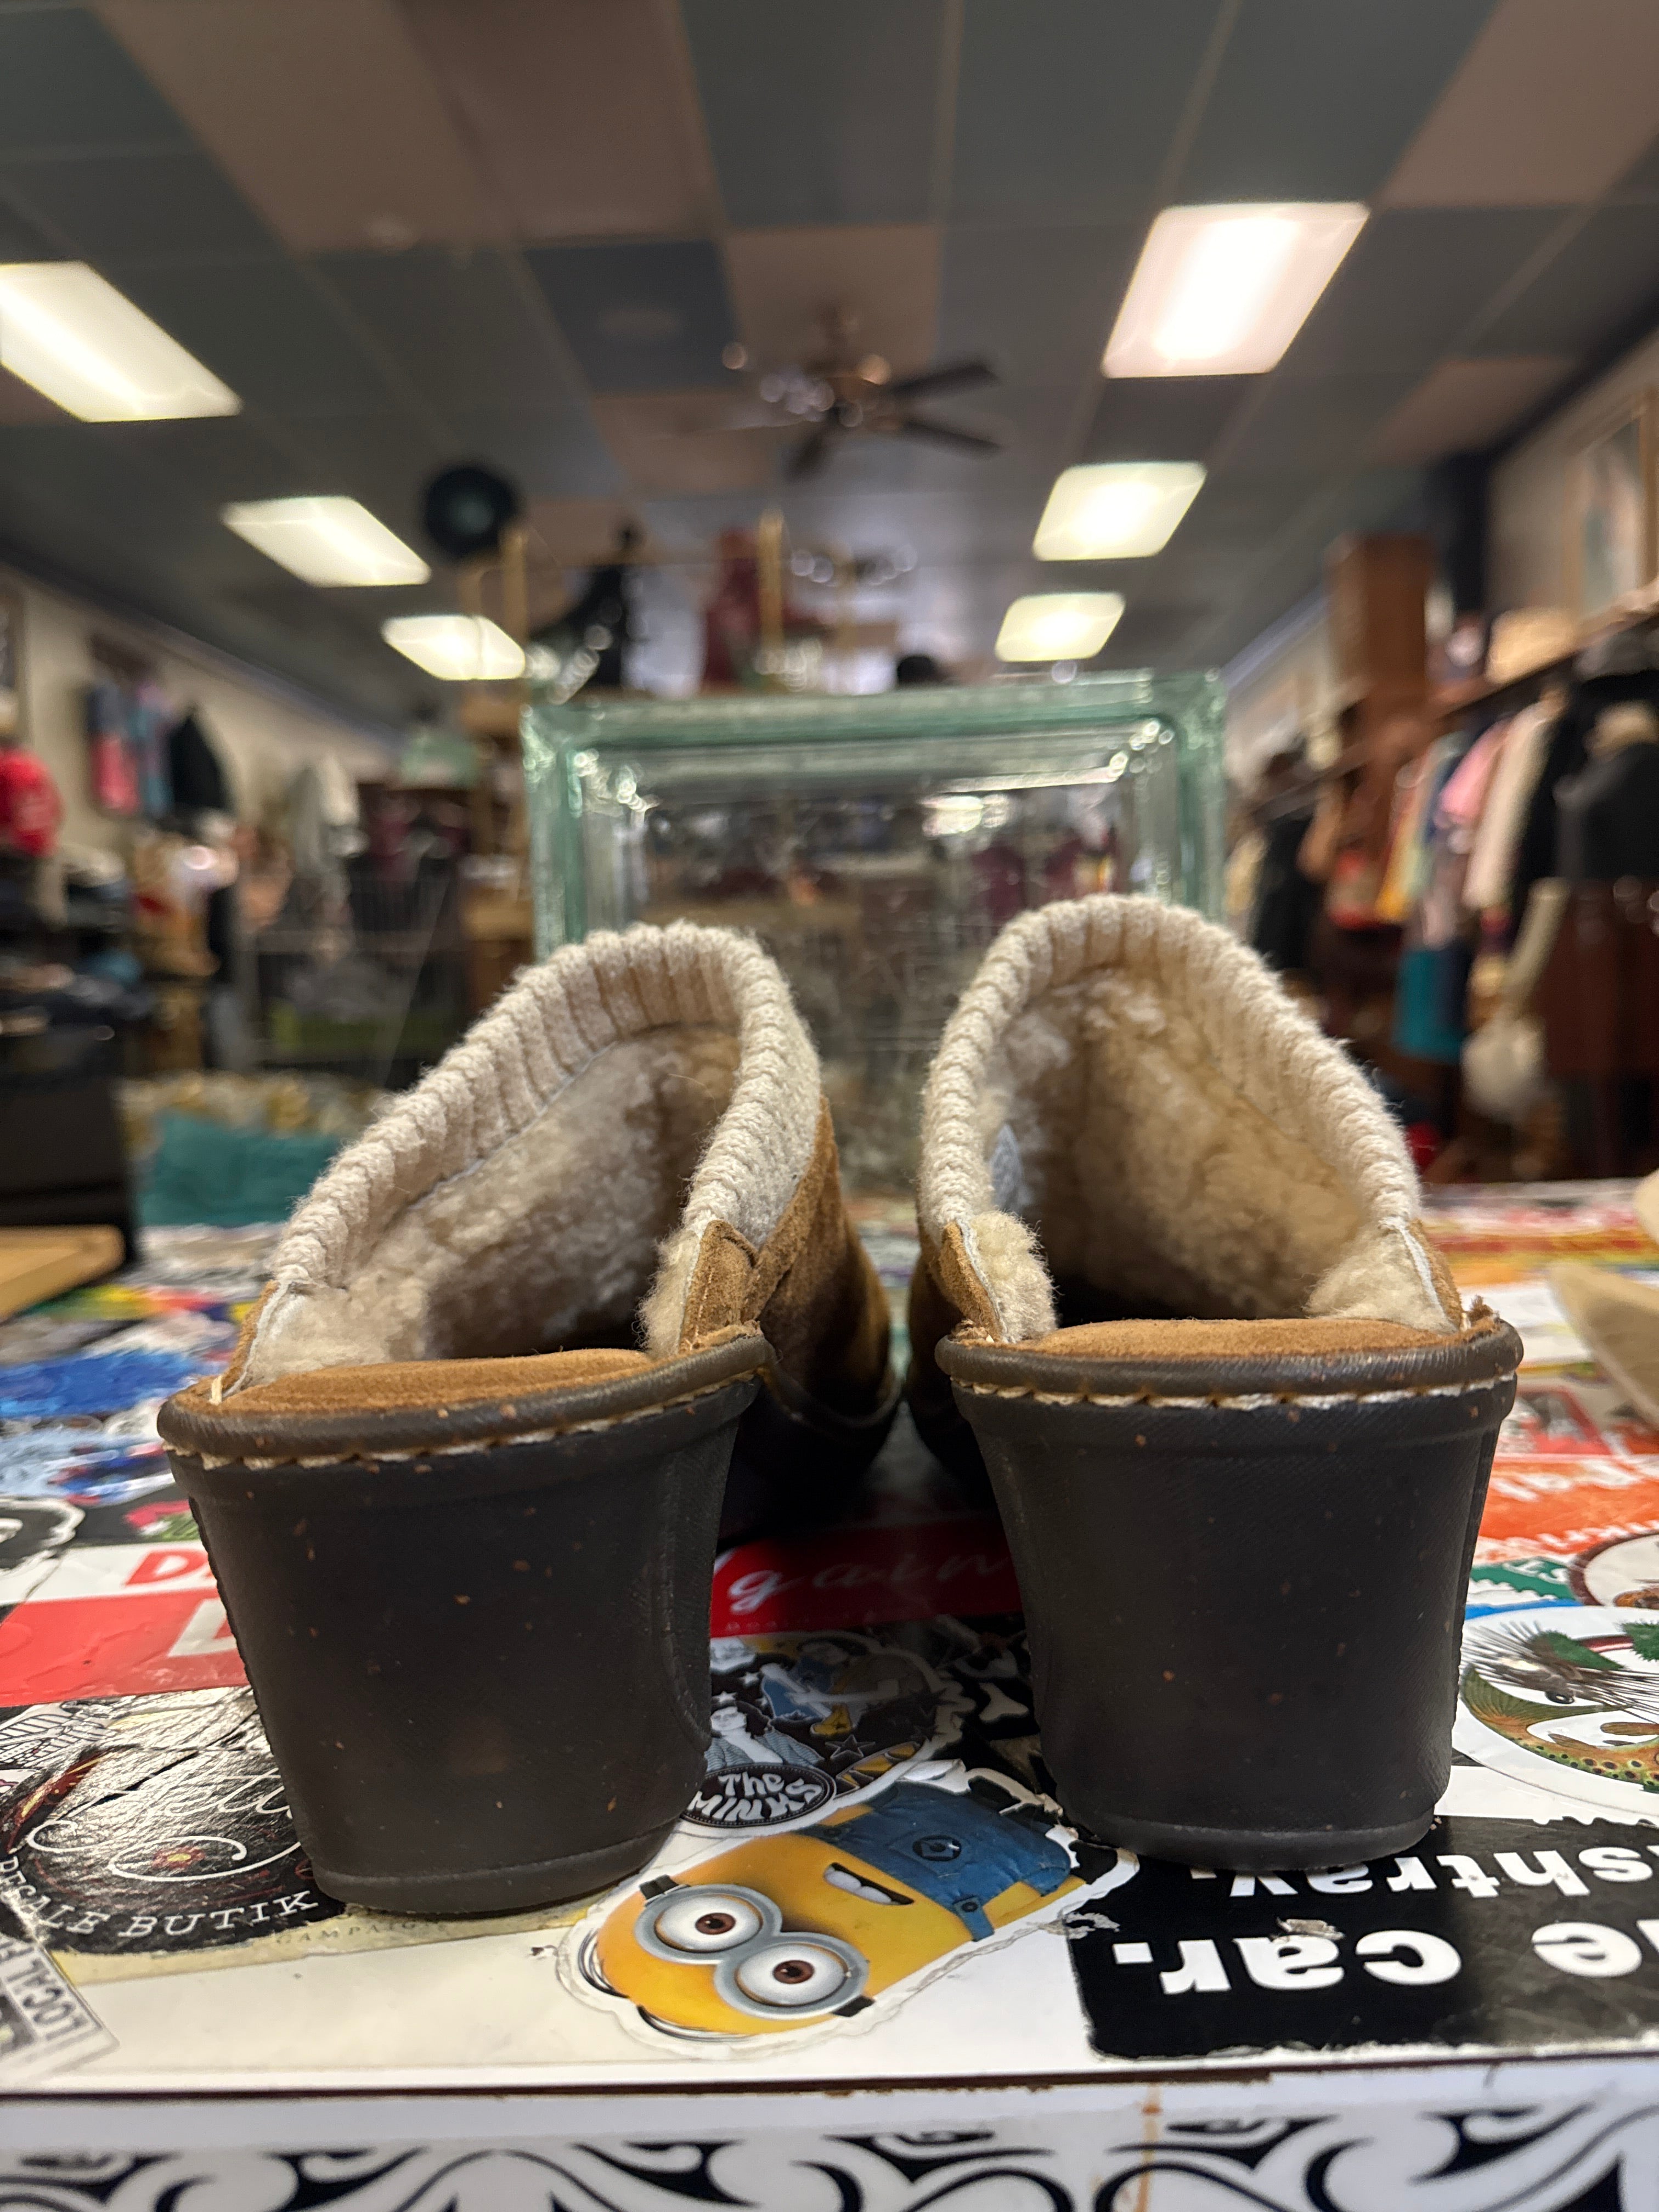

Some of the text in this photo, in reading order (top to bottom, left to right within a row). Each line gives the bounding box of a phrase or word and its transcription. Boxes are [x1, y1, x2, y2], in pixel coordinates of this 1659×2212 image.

[687, 1778, 822, 1821] MINKS
[718, 1771, 785, 1797] The
[117, 1890, 319, 1937] BUTIK
[1113, 1929, 1462, 1994] car.
[7, 1957, 89, 2040] LOCAL
